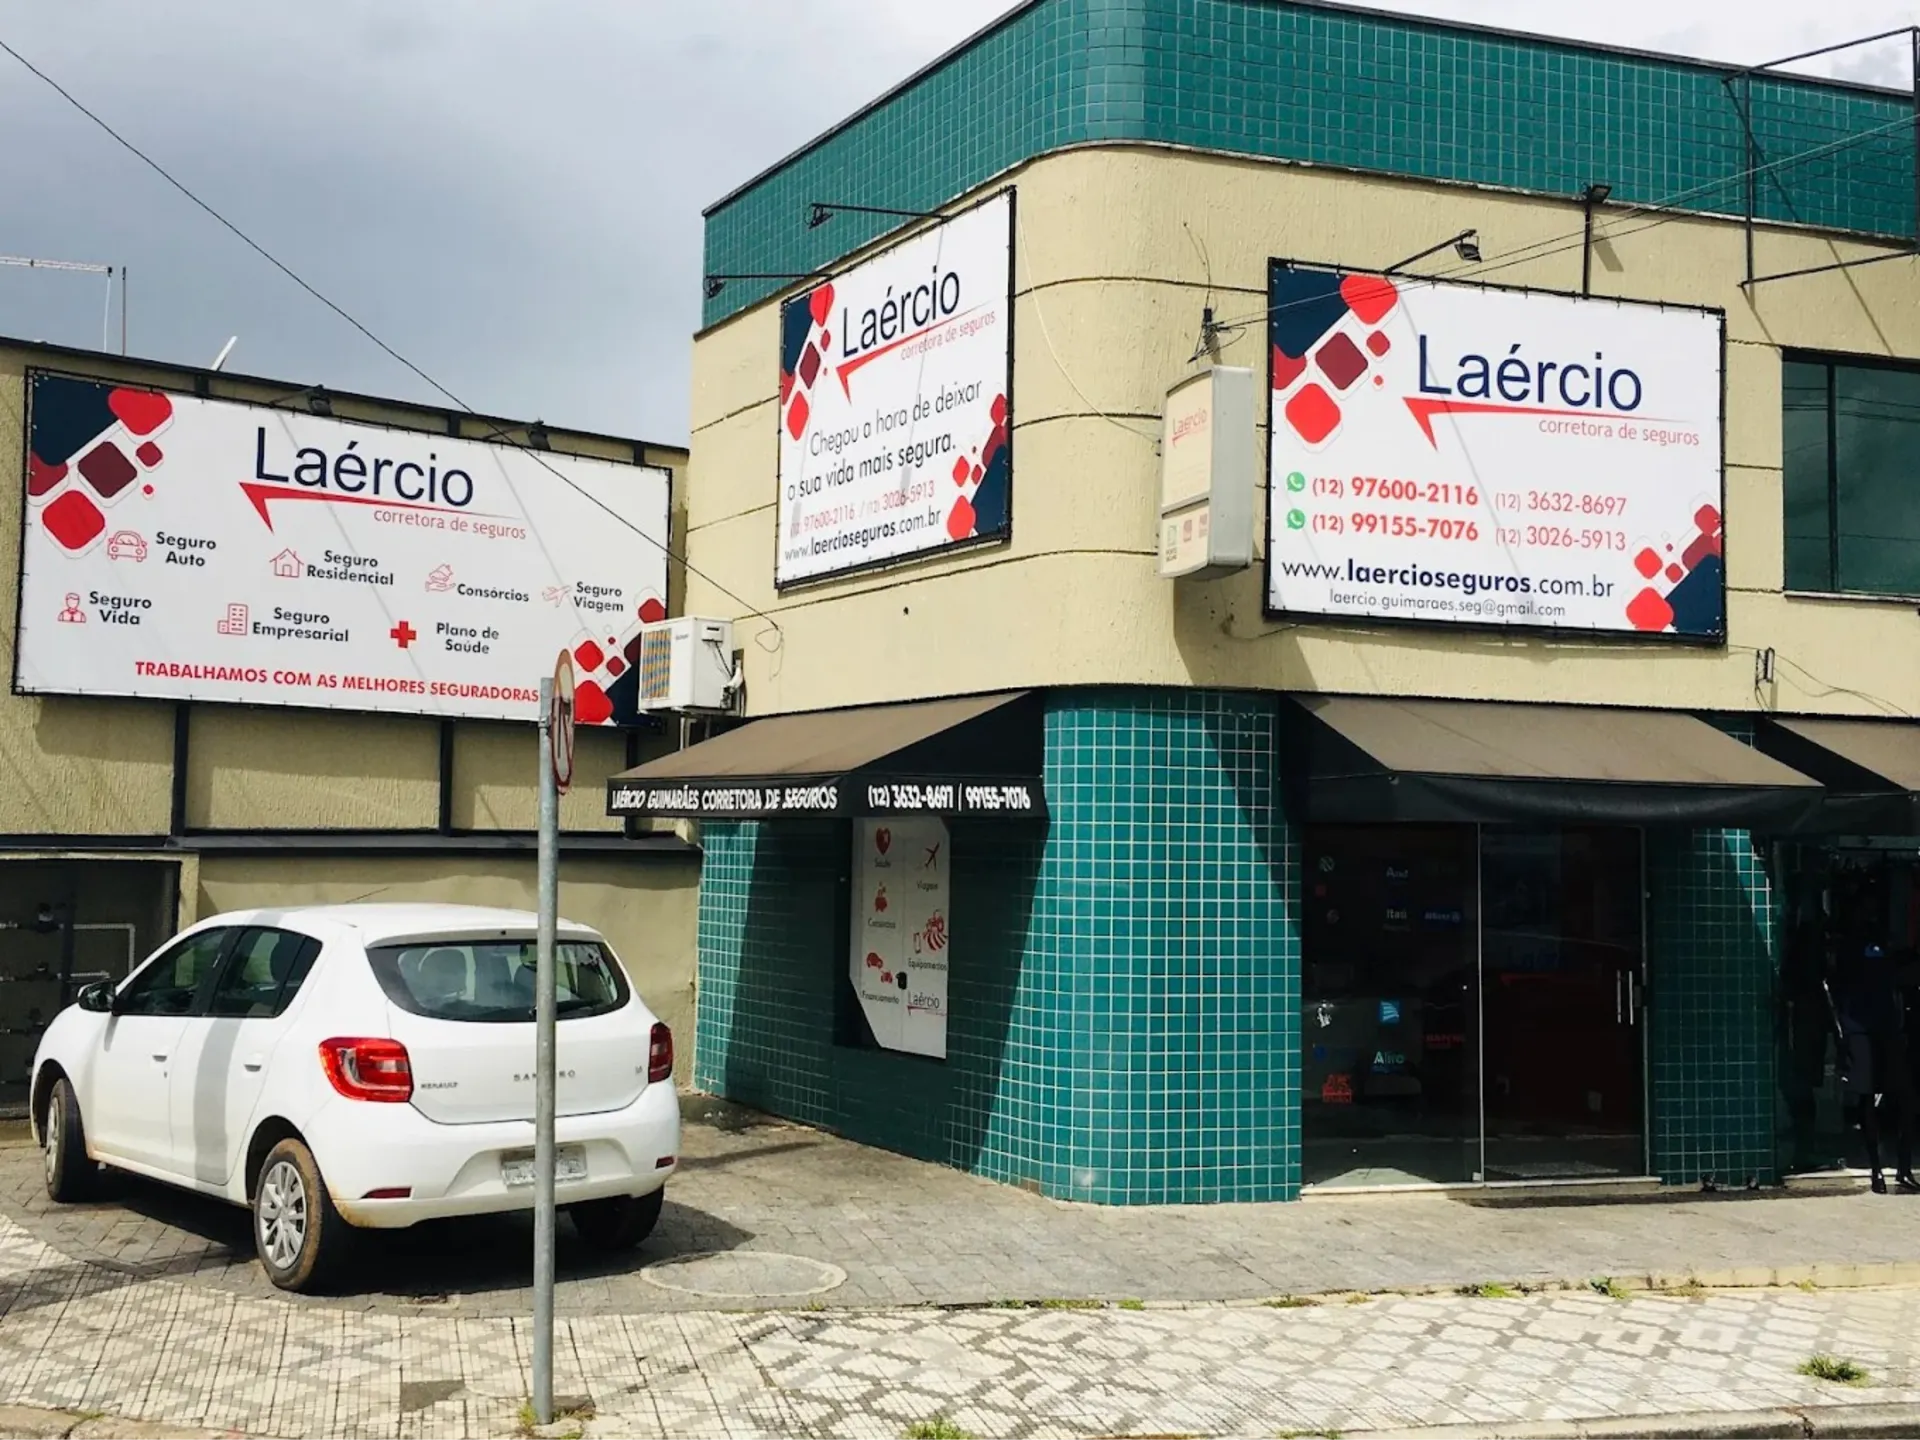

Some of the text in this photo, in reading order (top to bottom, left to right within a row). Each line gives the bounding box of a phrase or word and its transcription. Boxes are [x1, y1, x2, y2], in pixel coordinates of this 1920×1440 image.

[843, 265, 960, 358] Laércio
[901, 311, 996, 361] corretora de seguros
[1419, 334, 1642, 411] Laércio
[810, 380, 982, 456] Chegou a hora de deixar
[1538, 418, 1700, 447] corretora de seguros
[256, 426, 474, 507] Laércio
[799, 477, 821, 497] sua
[826, 459, 854, 487] vida
[859, 447, 894, 478] mais
[898, 433, 956, 468] segura.
[803, 505, 855, 532] 97600-2116
[882, 480, 935, 511] 3026-5913
[1311, 477, 1627, 517] (12) 97600-2116 (12) 3632-8697
[374, 509, 526, 541] corretora de seguros
[784, 504, 941, 562] www.laercioseguros.com.br
[1311, 512, 1627, 551] (12) 99155-7076 (12) 3026-5913
[156, 532, 216, 551] Seguro
[165, 551, 206, 567] Auto
[324, 550, 378, 569] Seguro
[306, 565, 394, 585] Residencial
[1282, 558, 1615, 598] www.laercioseguros.com.br
[89, 591, 152, 609] Seguro
[457, 584, 529, 602] Consórcios
[576, 582, 622, 598] Seguro
[1330, 589, 1566, 617] laercio.guimaraes.seg@gmail.com
[99, 609, 140, 625] Vida
[273, 607, 330, 625] Seguro
[573, 597, 624, 614] Viagem
[252, 622, 349, 642] Empresarial
[436, 622, 499, 640] Plano de
[445, 637, 490, 655] Saúde
[135, 661, 539, 703] TRABALHAMOS COM AS MELHORES SEGURADORAS
[702, 789, 761, 810] CORRETORA
[764, 789, 781, 810] DE
[782, 787, 837, 810] SEGUROS
[867, 785, 890, 809] (12)
[891, 785, 954, 808] 3632-8697
[965, 786, 1031, 809] 99155-7076
